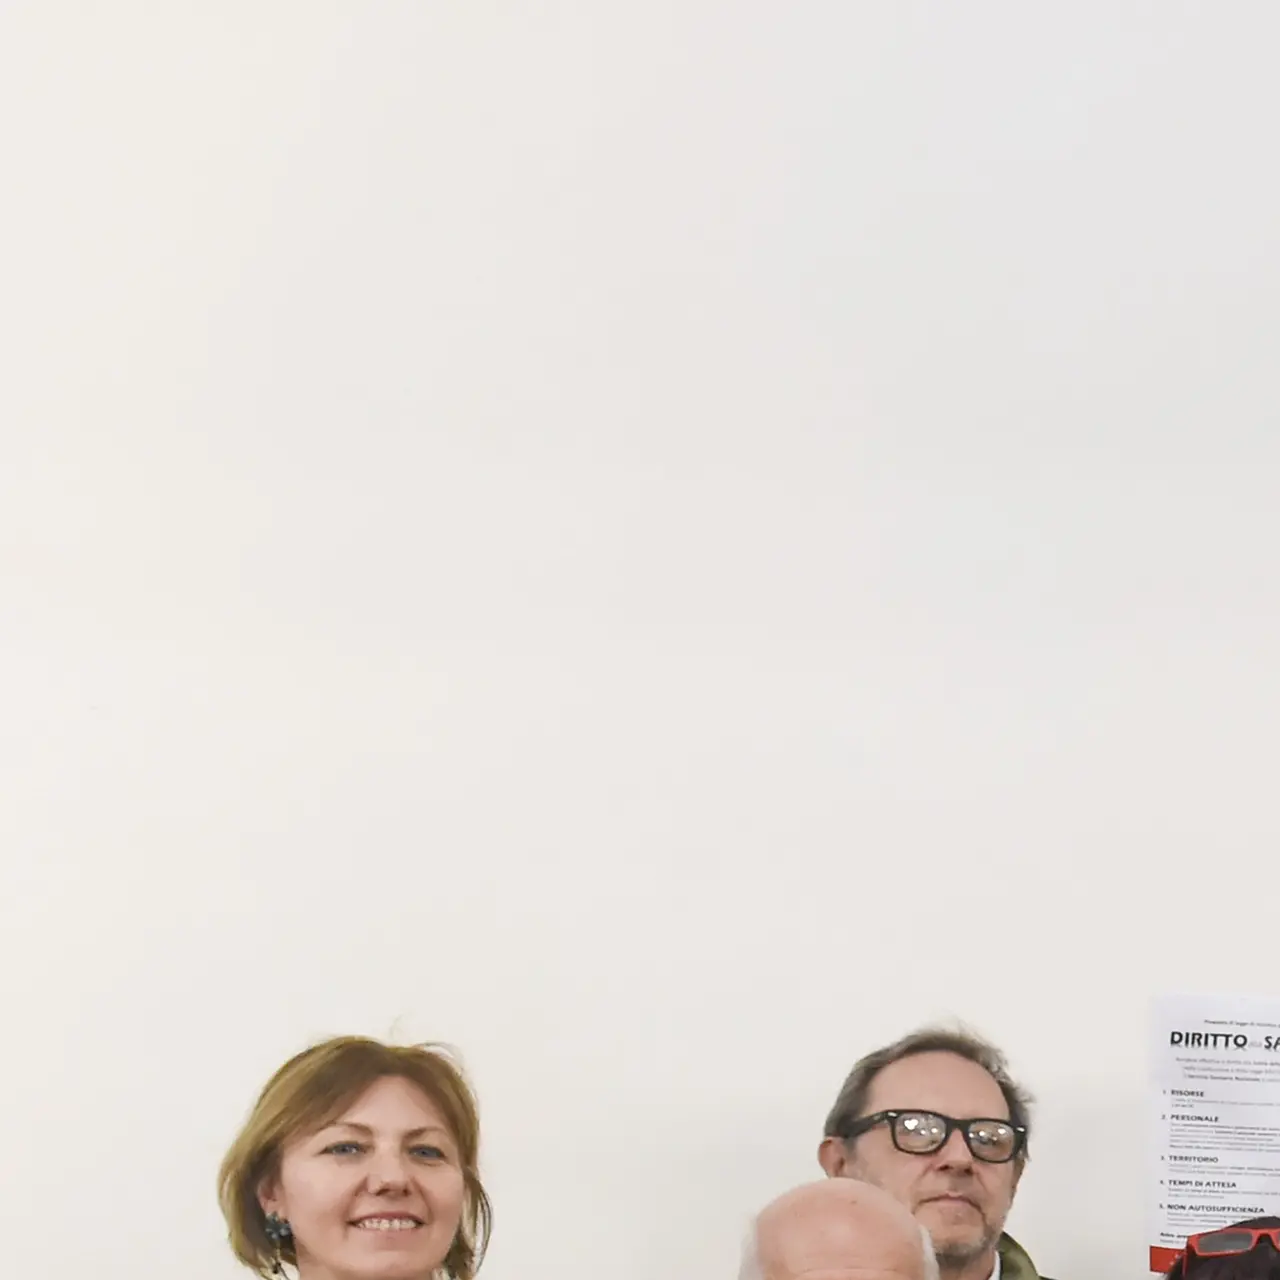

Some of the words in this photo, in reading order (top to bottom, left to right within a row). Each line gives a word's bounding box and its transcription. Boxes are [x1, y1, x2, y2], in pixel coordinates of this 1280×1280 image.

[1170, 1031, 1248, 1048] DIRITTO
[1170, 1089, 1204, 1097] RISORSE
[1170, 1114, 1219, 1122] PERSONALE
[1188, 1205, 1265, 1213] AUTOSUFFICIENZA
